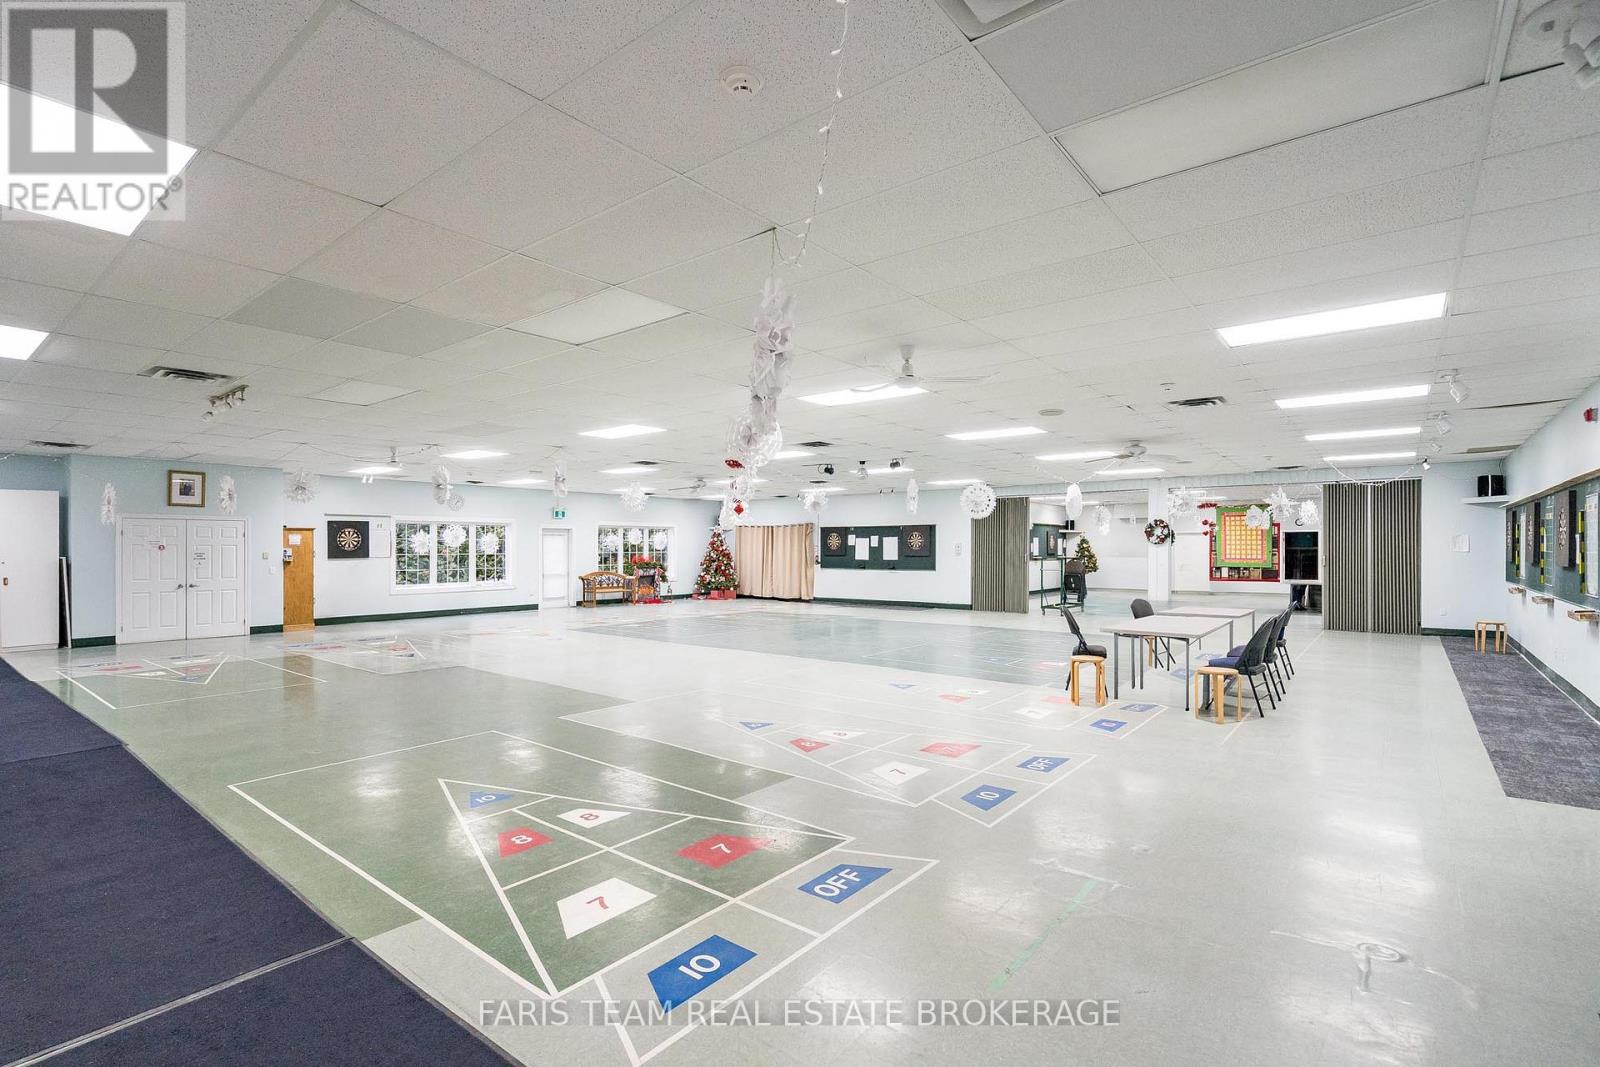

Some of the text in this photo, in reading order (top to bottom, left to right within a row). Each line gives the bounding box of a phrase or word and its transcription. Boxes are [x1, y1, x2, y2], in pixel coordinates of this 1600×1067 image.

[510, 834, 533, 845] 8
[710, 842, 732, 855] 7
[813, 868, 862, 898] OFF
[586, 896, 609, 910] 7
[678, 954, 721, 981] 10
